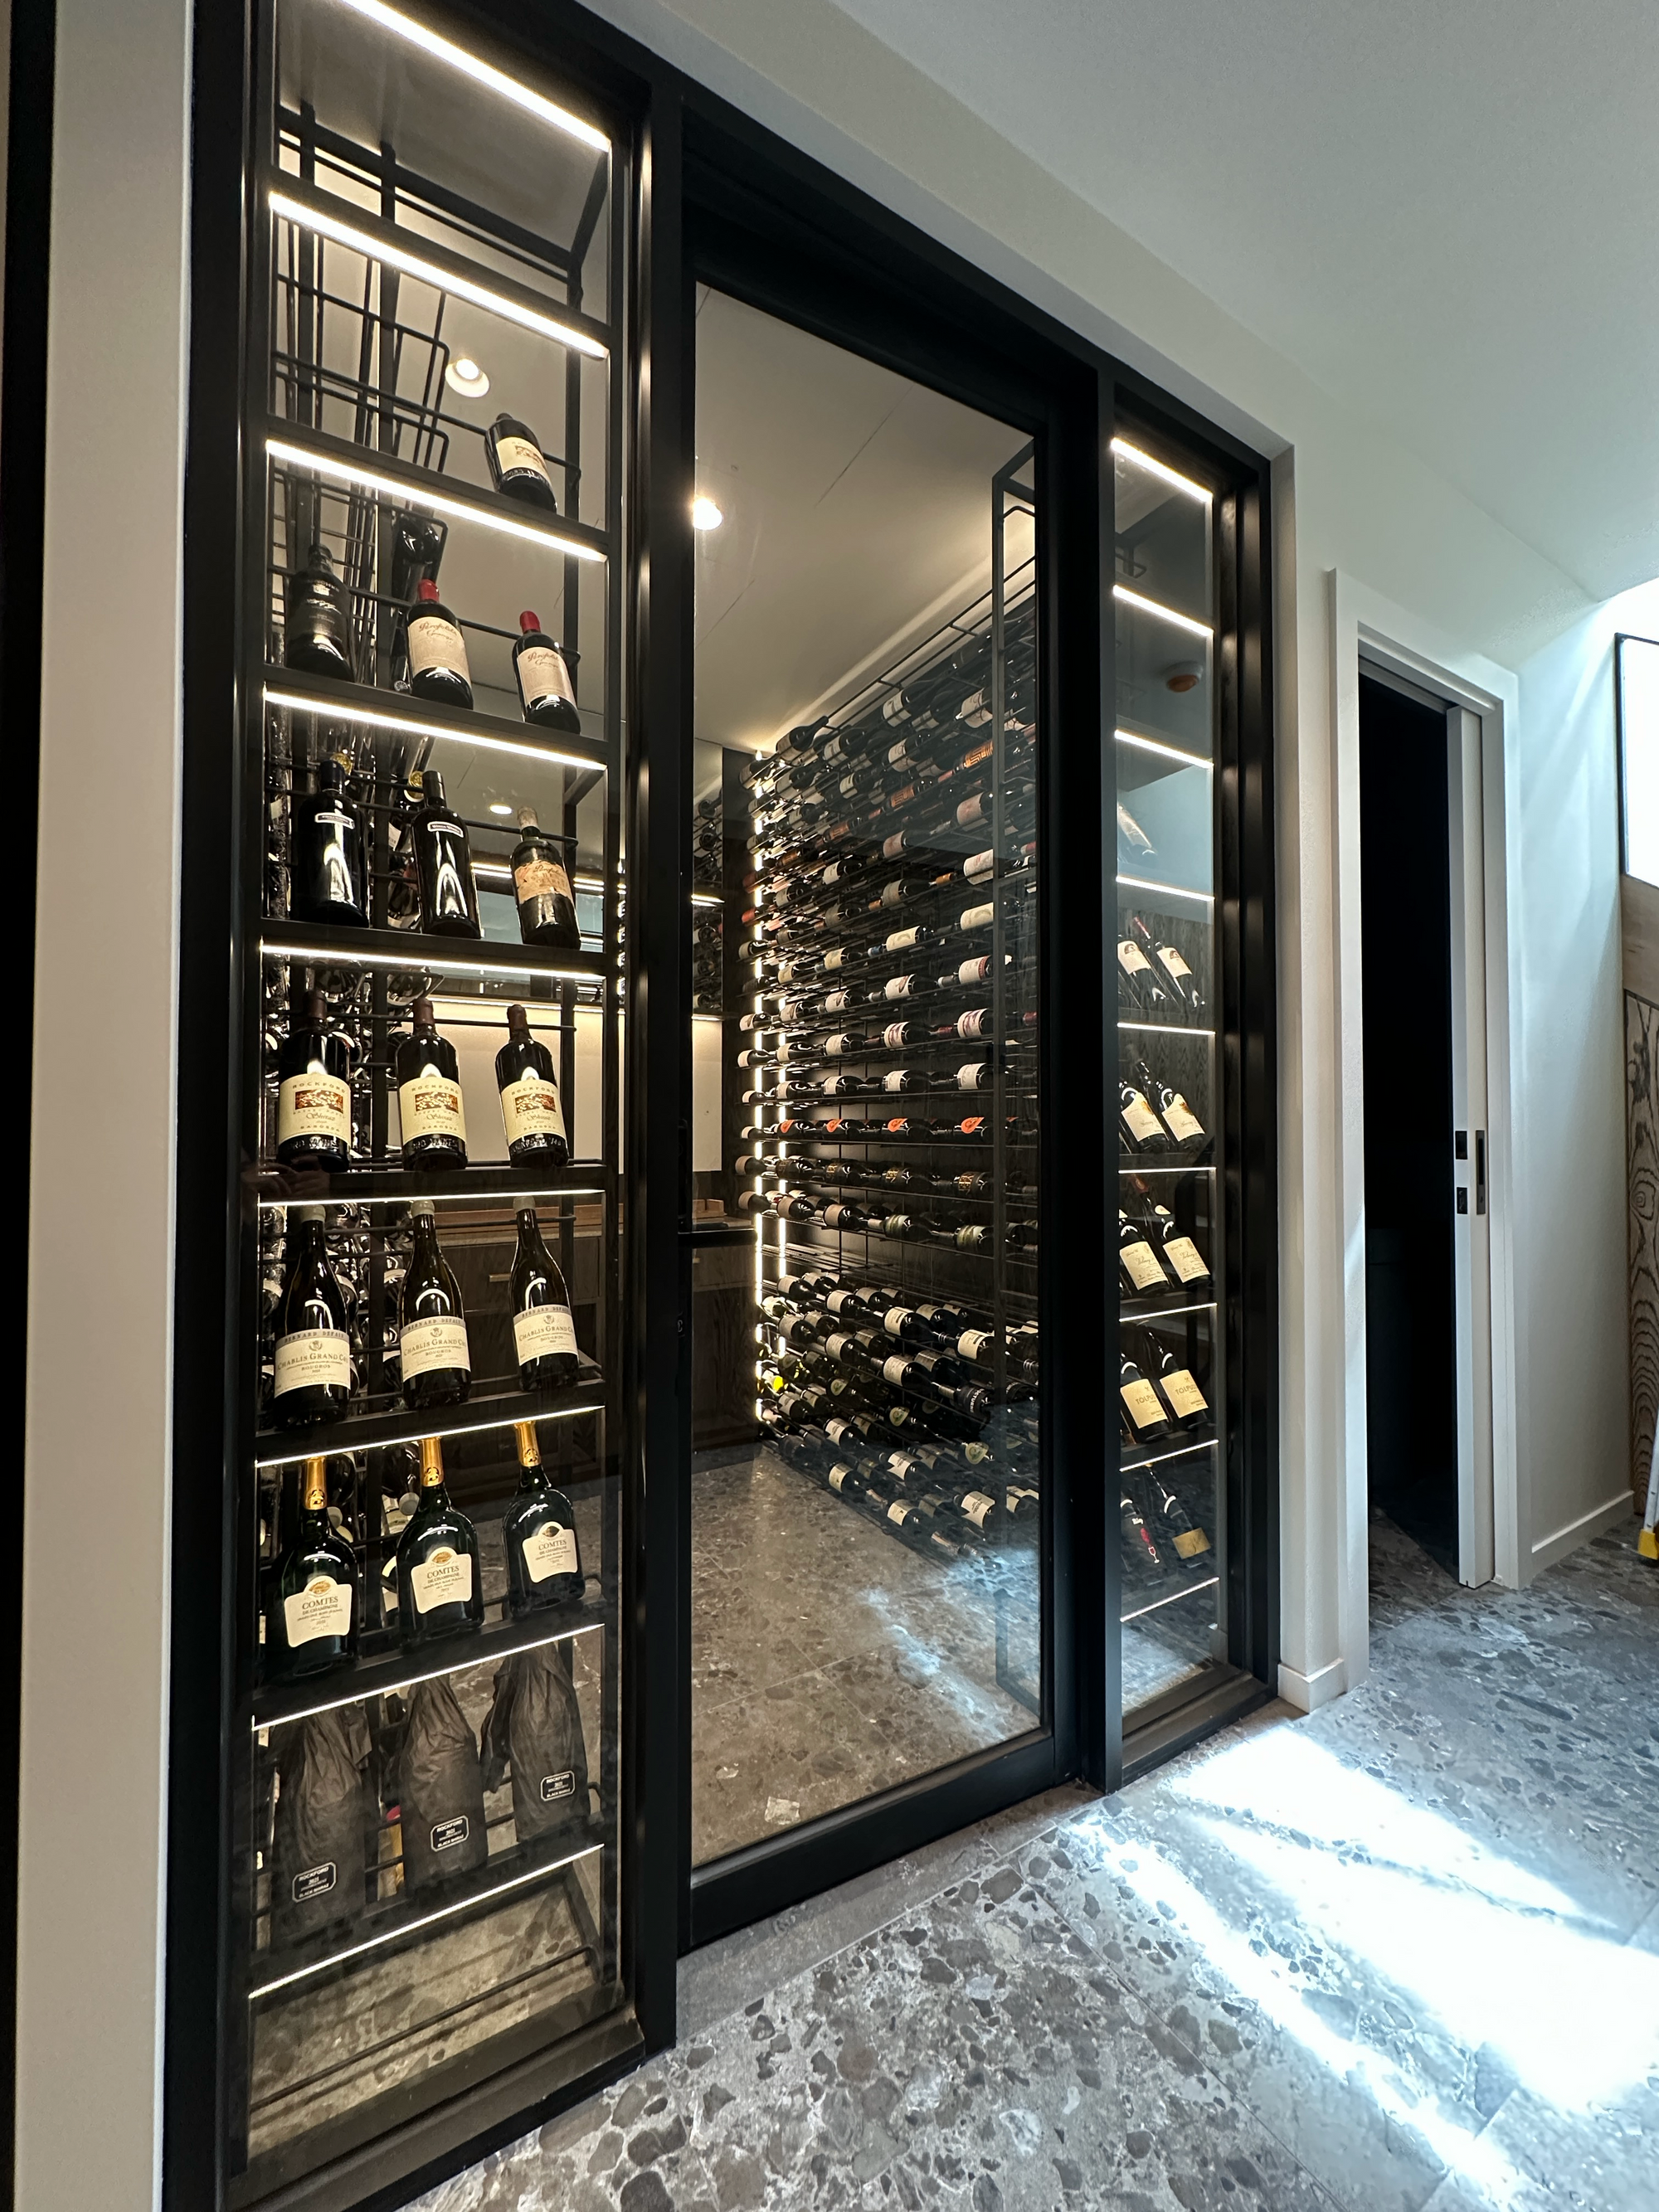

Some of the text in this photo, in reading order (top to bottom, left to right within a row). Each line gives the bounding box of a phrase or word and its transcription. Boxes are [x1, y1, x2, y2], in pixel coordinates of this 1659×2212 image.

[292, 1082, 345, 1093] ROCKFORD
[407, 1319, 437, 1331] BERNARD
[284, 1331, 317, 1343] BERNARD
[404, 1341, 430, 1356] CHABLIS
[277, 1355, 308, 1370] CHABLIS
[538, 1539, 567, 1551] COMTES
[427, 1566, 460, 1578] COMTES
[302, 1596, 338, 1610] COMTES
[546, 1773, 570, 1783] ROCKFORD
[436, 1819, 463, 1833] ROCKFORD
[299, 1866, 329, 1881] ROCKFORD
